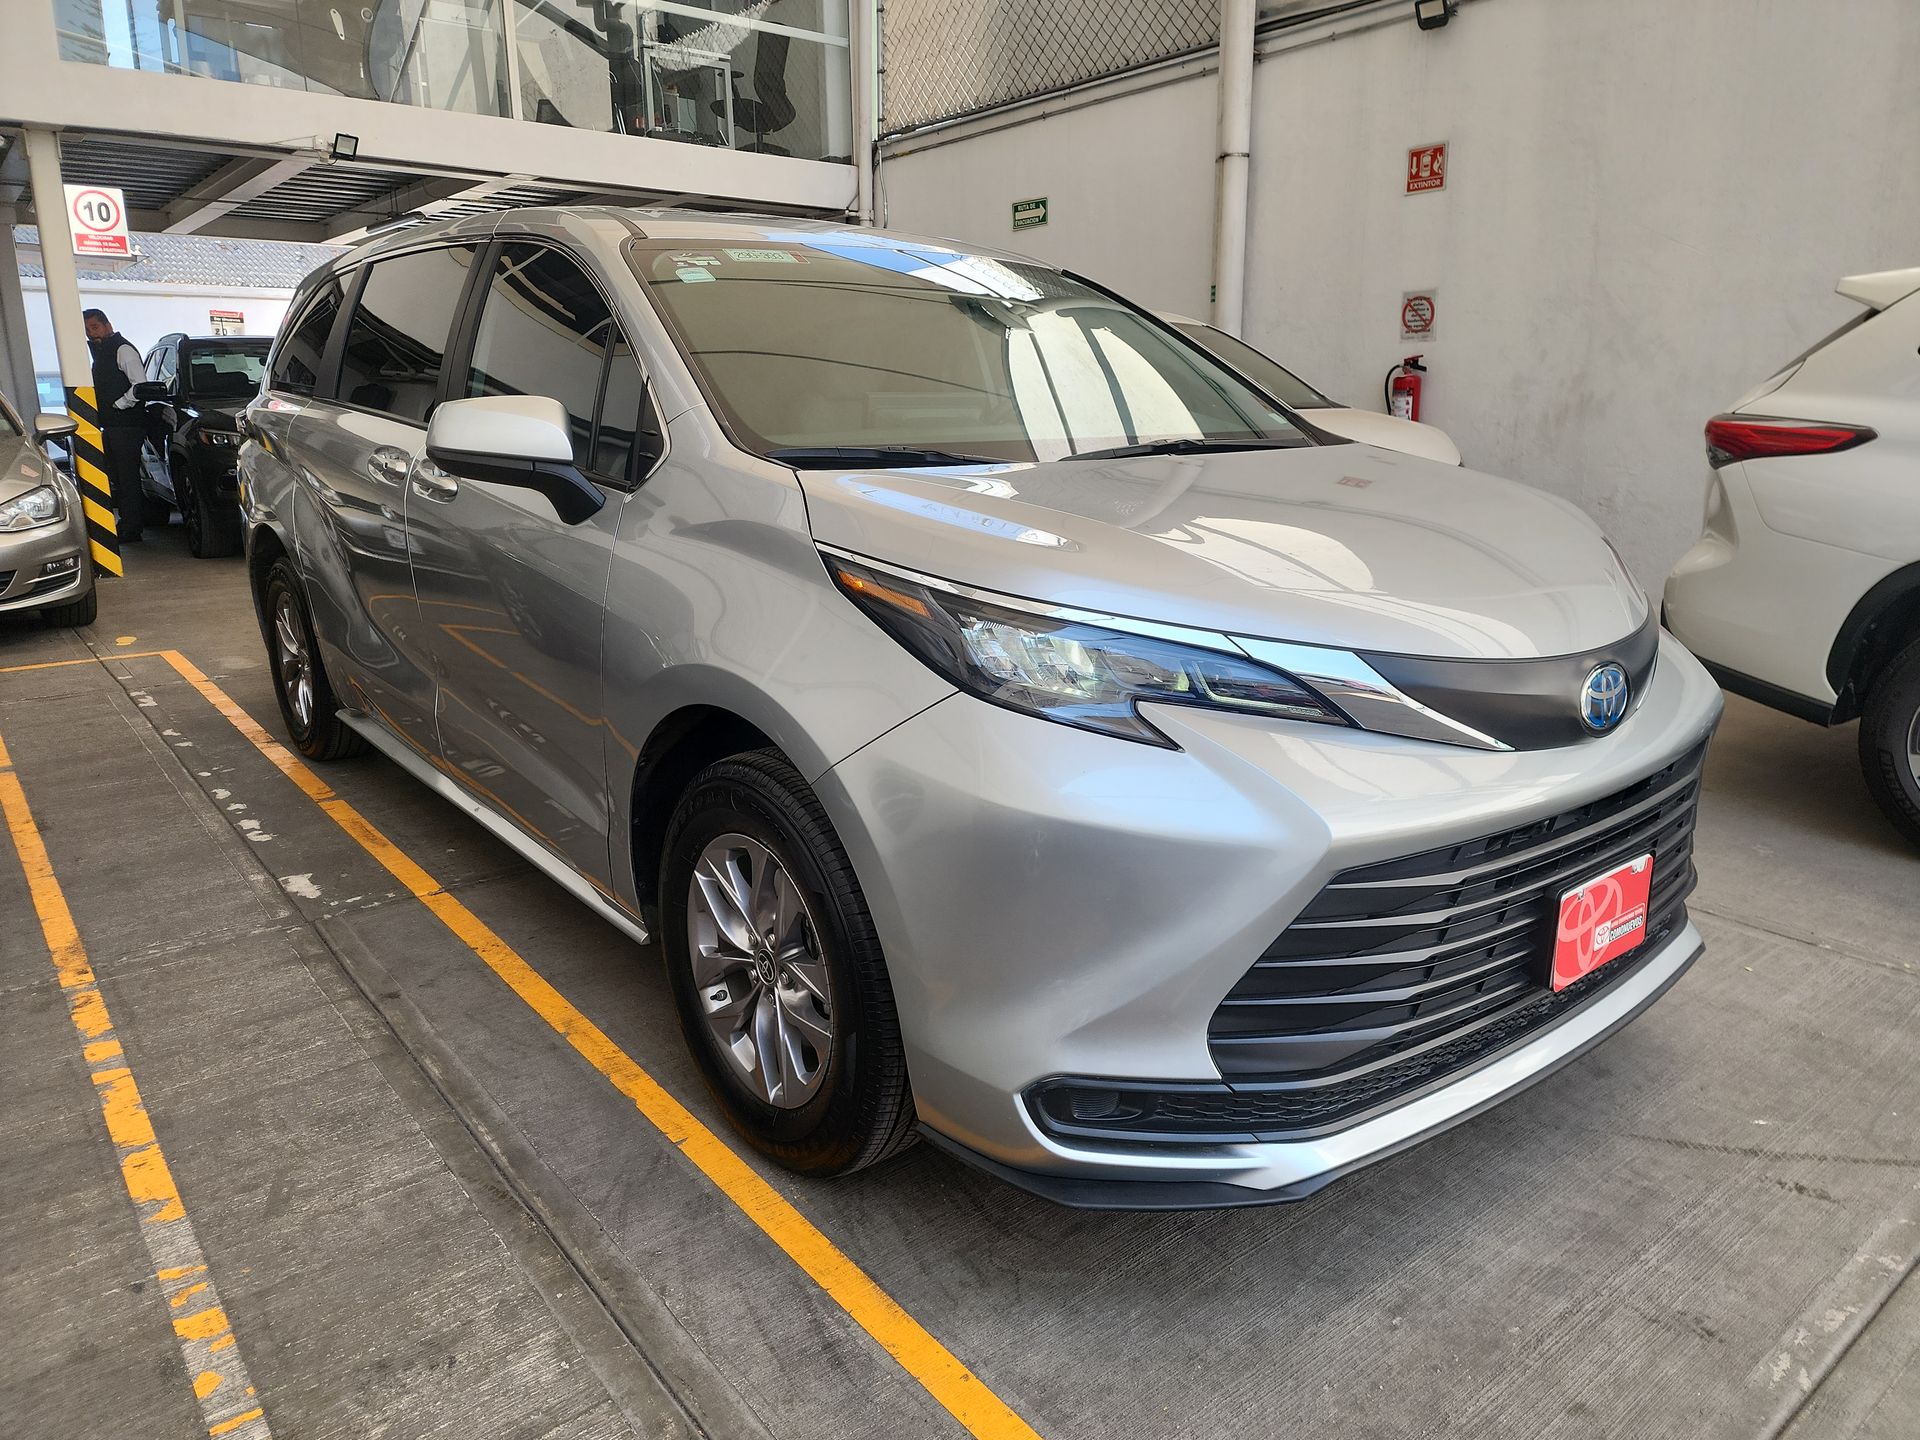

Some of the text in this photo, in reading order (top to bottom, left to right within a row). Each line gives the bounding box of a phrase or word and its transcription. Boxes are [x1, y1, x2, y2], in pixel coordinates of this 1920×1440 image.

[1409, 179, 1441, 190] EXTINTOR
[83, 201, 111, 222] 10
[1610, 915, 1642, 940] COMONUEVOS
